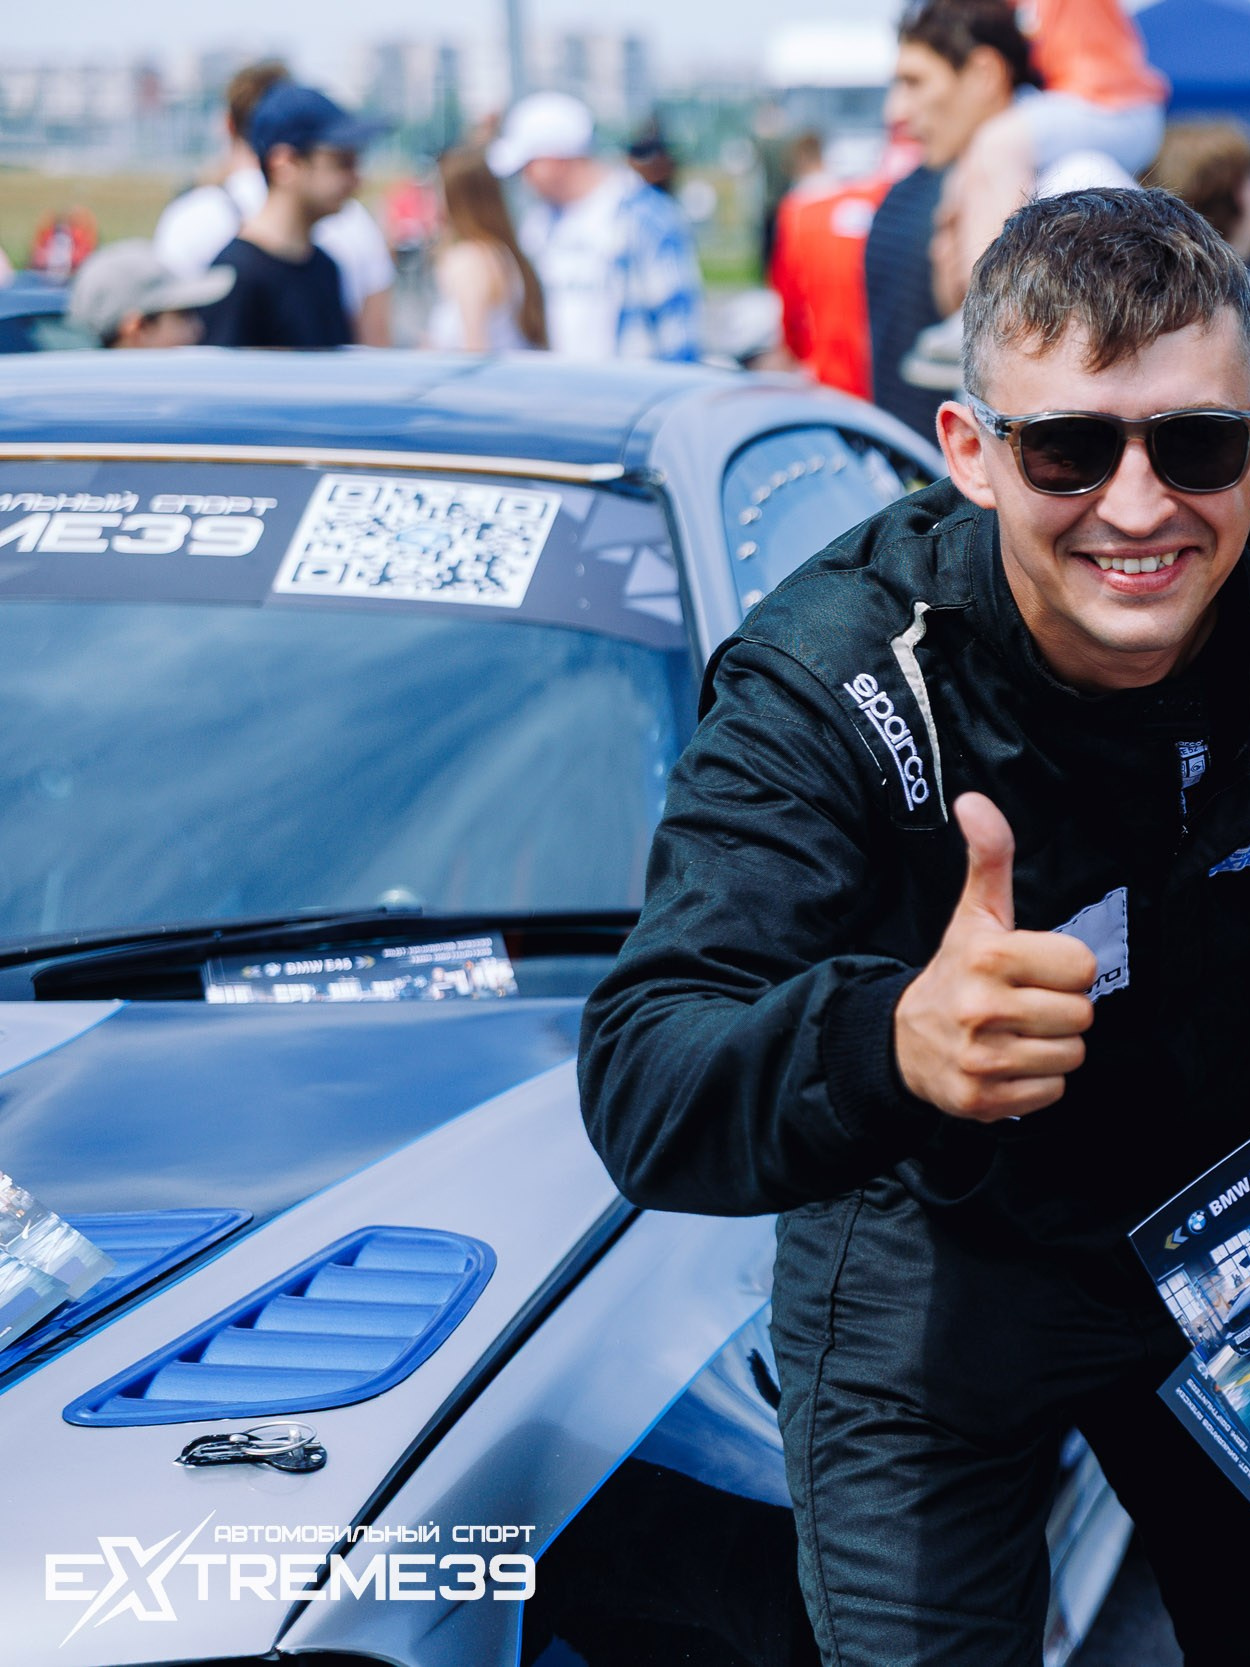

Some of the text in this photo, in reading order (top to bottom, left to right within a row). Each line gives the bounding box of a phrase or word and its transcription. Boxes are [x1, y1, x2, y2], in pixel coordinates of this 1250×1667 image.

[151, 494, 278, 516] СПОРТ
[844, 673, 930, 811] sparco
[1208, 1177, 1250, 1217] BMW
